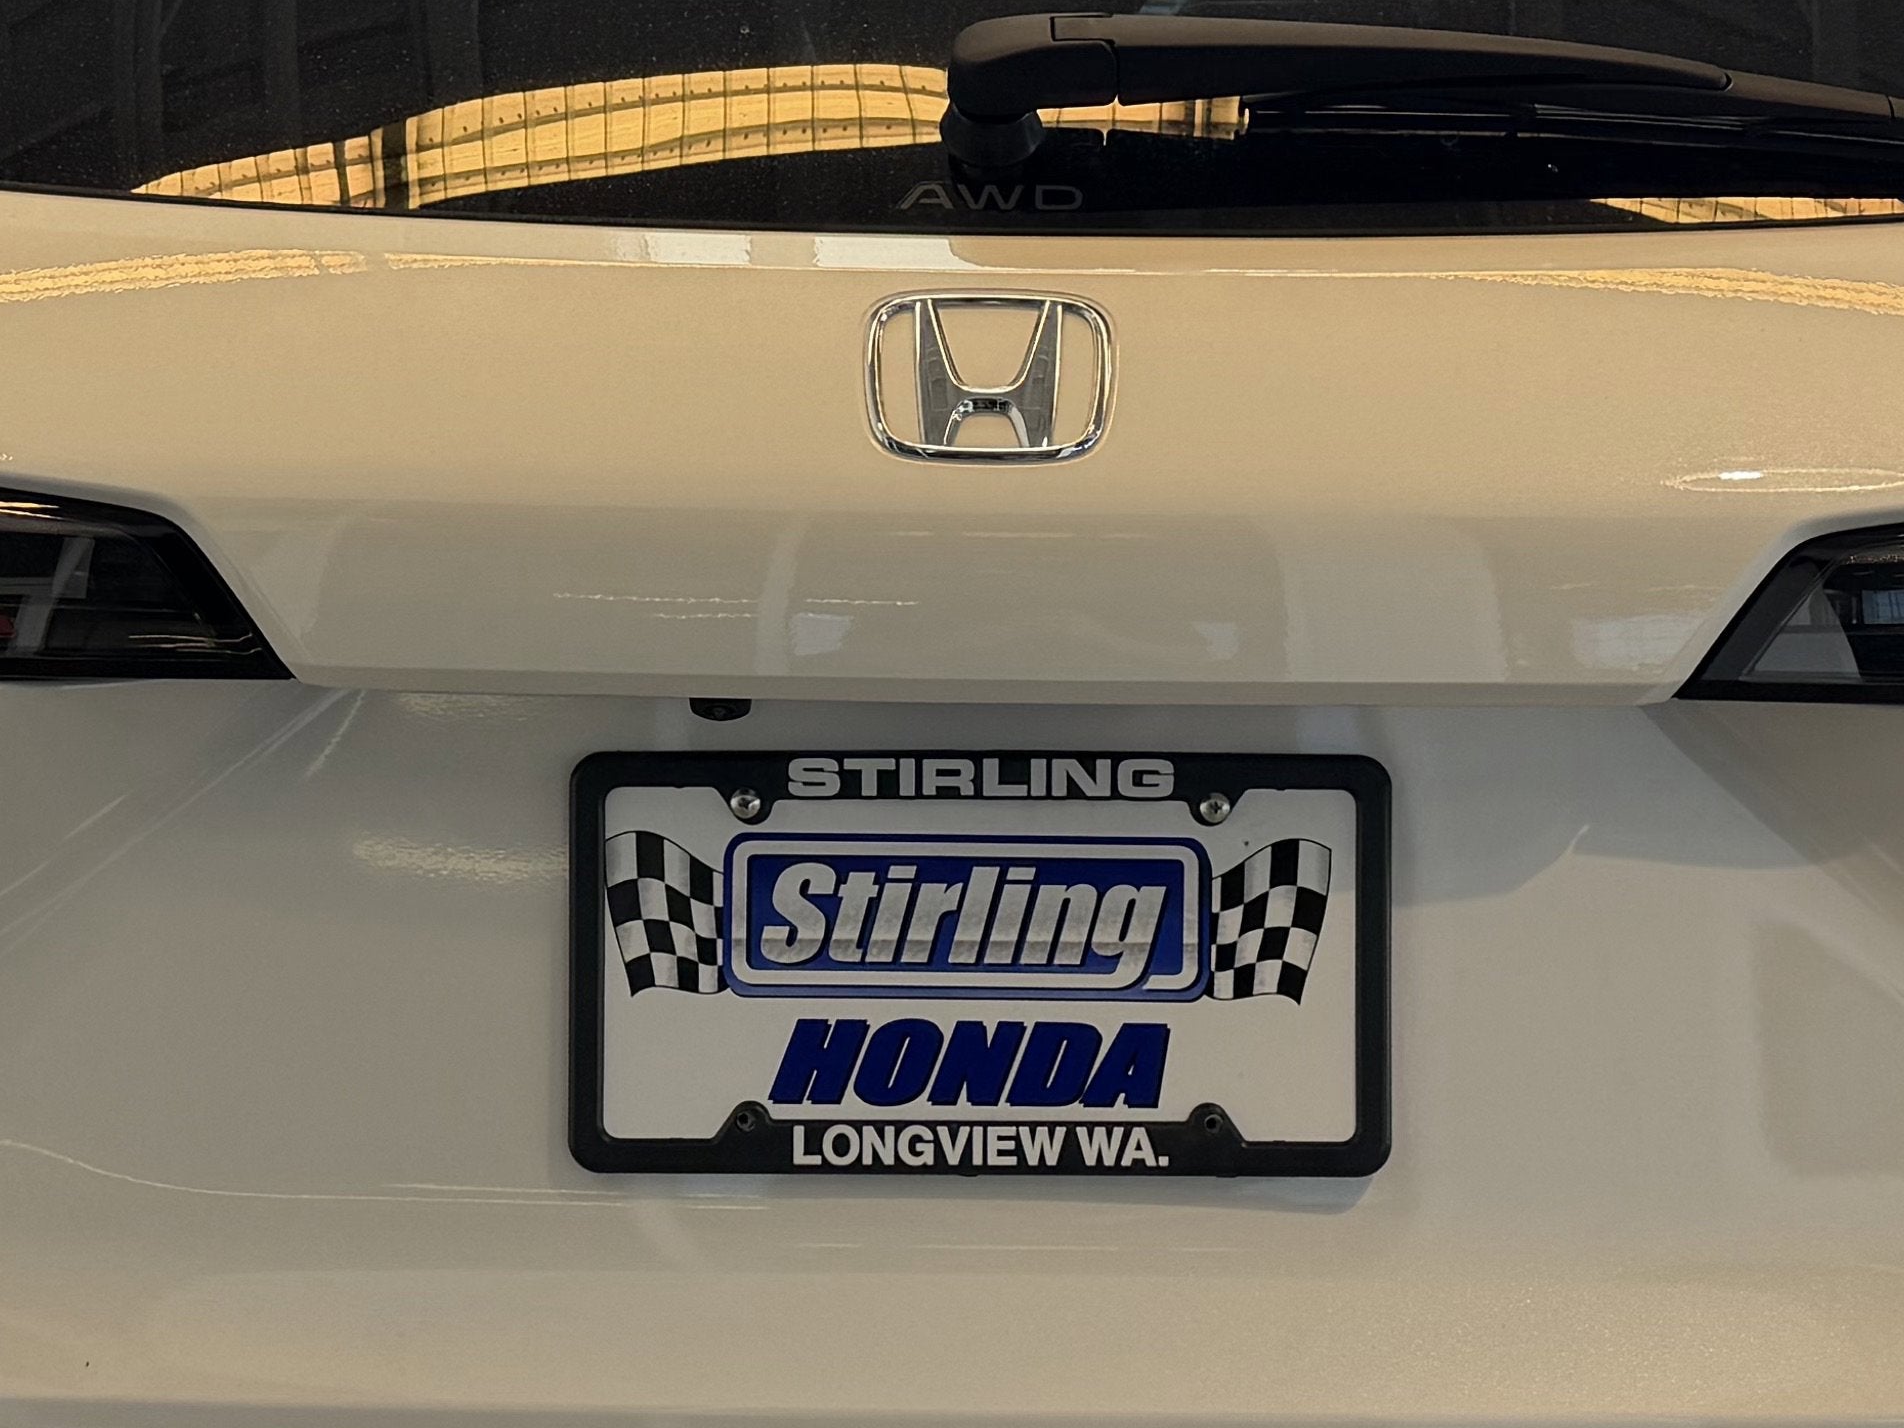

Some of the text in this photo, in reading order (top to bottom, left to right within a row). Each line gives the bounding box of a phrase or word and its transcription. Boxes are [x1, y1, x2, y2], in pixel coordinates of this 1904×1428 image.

[896, 180, 1084, 211] AWD
[786, 757, 1175, 799] STIRLING
[758, 860, 1168, 988] Stirling
[767, 1018, 1171, 1109] HONDA
[792, 1124, 1170, 1167] LONGVIEW WA.
